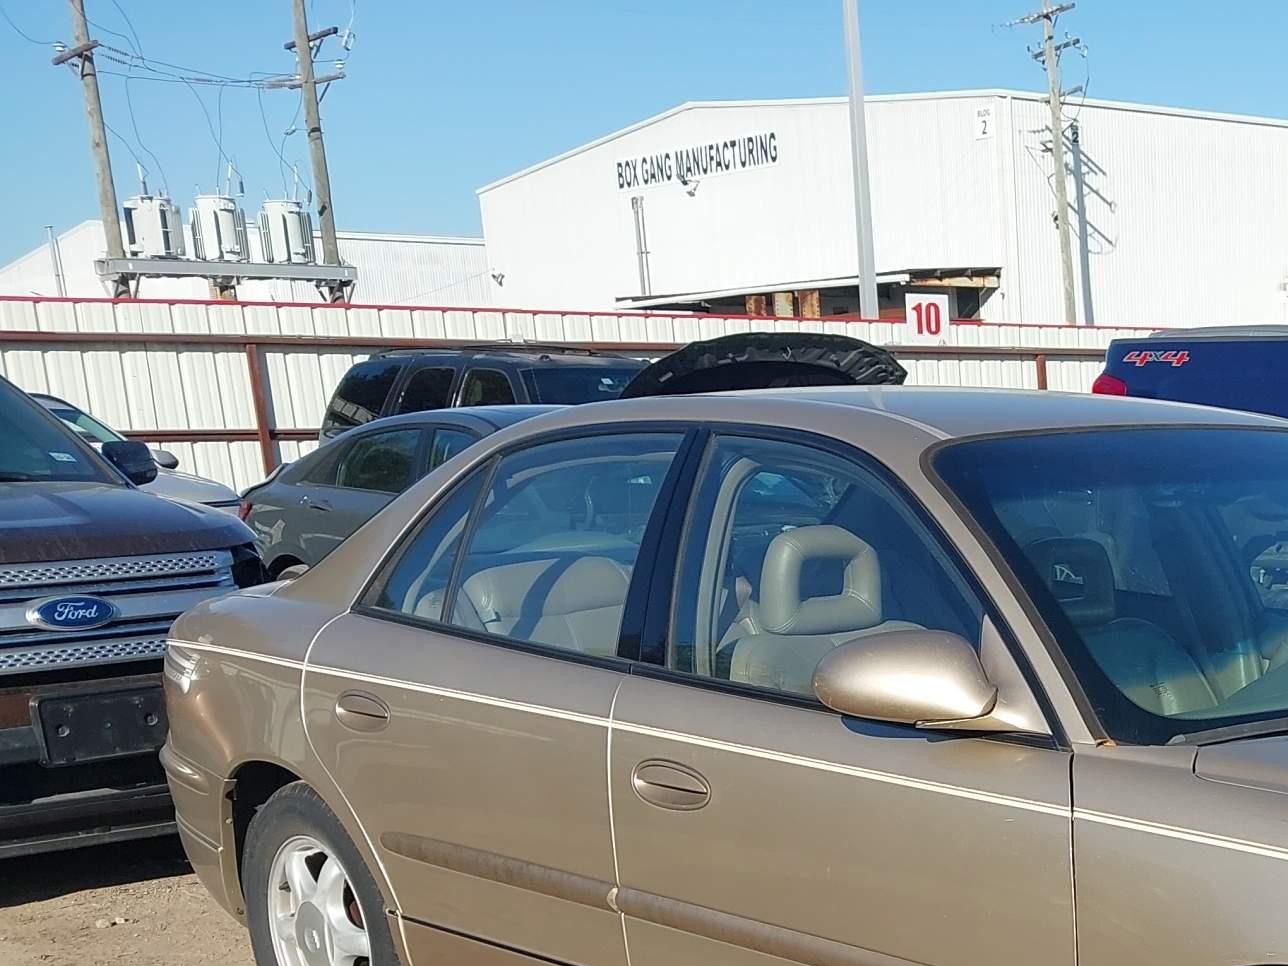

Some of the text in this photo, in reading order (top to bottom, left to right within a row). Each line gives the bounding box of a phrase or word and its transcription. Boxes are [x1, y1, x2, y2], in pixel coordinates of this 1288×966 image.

[981, 120, 988, 135] 2
[1071, 131, 1080, 143] 2
[616, 132, 778, 189] BOX GANG MANUFACTURING
[911, 302, 941, 336] 10
[54, 601, 98, 621] Ford
